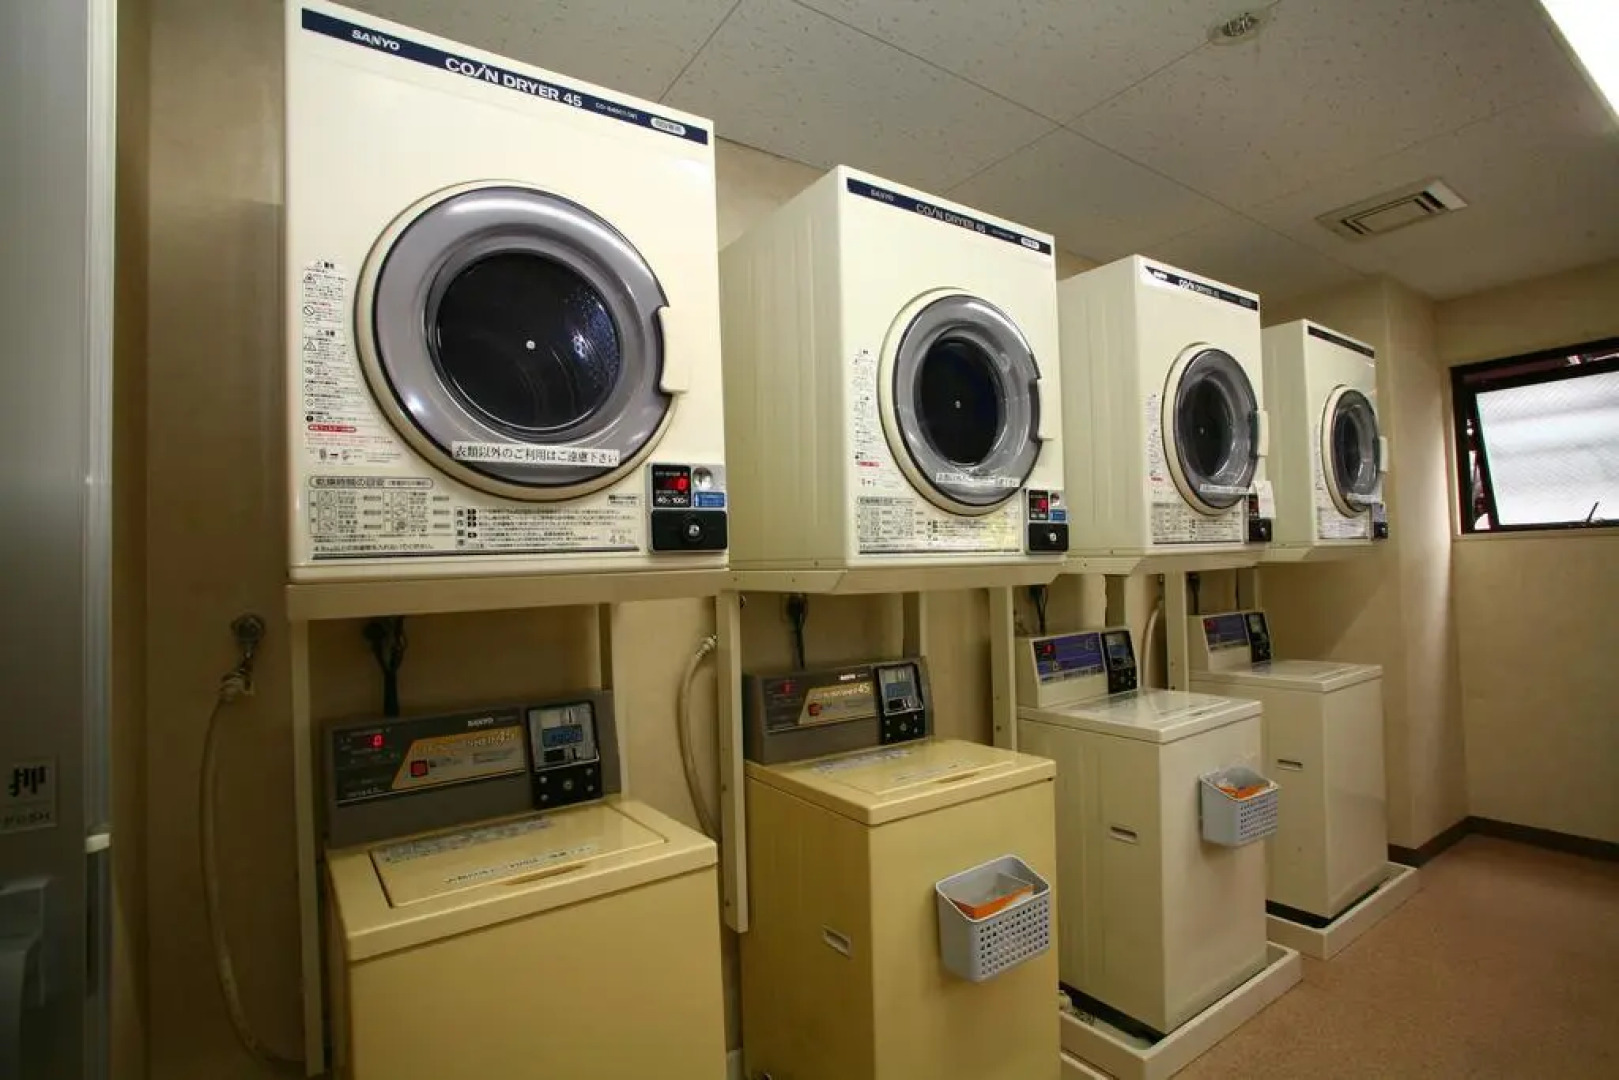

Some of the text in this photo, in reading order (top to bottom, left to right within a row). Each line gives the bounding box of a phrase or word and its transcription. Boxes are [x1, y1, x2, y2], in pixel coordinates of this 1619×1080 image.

[352, 29, 400, 51] SANYO
[503, 73, 560, 101] DRYER
[563, 88, 583, 108] 45
[870, 188, 894, 203] SANYO
[944, 212, 975, 231] DRYER
[455, 445, 619, 464] 衣類以外のご利用はご遠慮下さい
